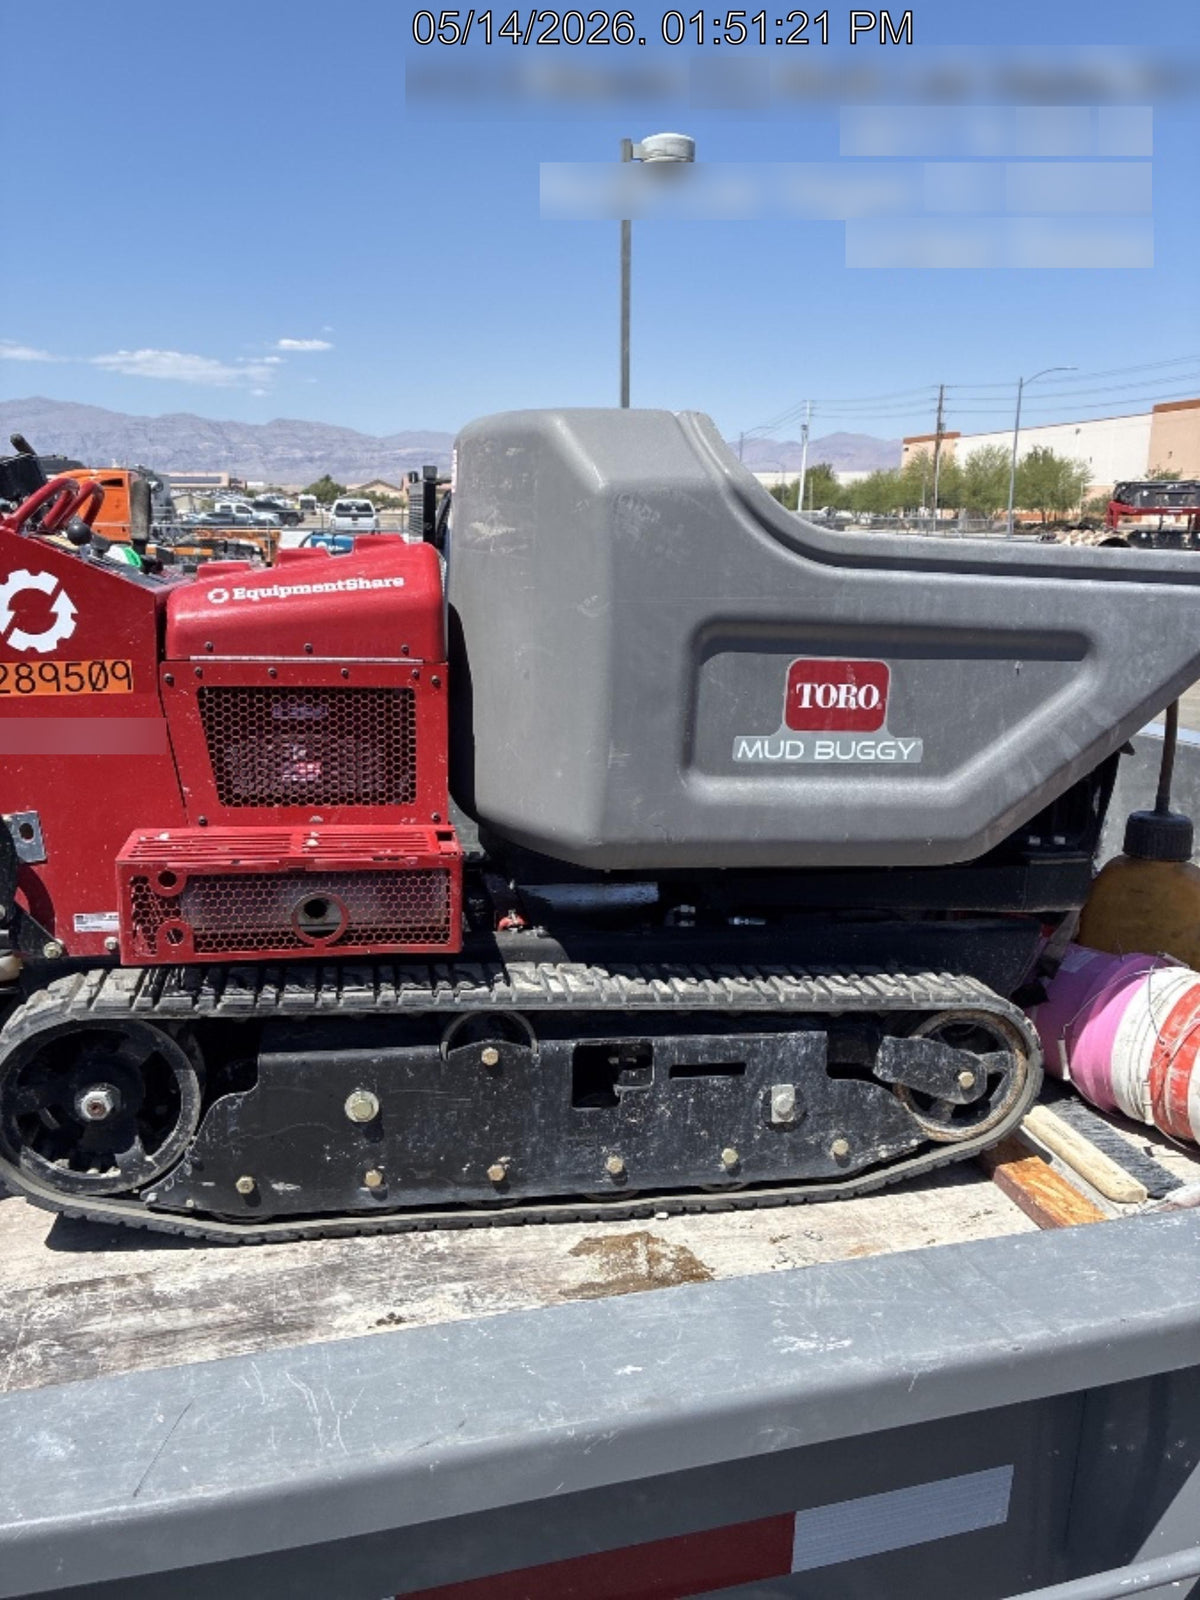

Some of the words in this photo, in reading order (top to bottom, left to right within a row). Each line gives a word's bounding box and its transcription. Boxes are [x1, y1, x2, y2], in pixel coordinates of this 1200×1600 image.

[232, 577, 404, 601] EquipmentShare
[796, 682, 880, 710] TORO
[737, 739, 804, 760] MUD
[814, 740, 916, 760] BUGGY
